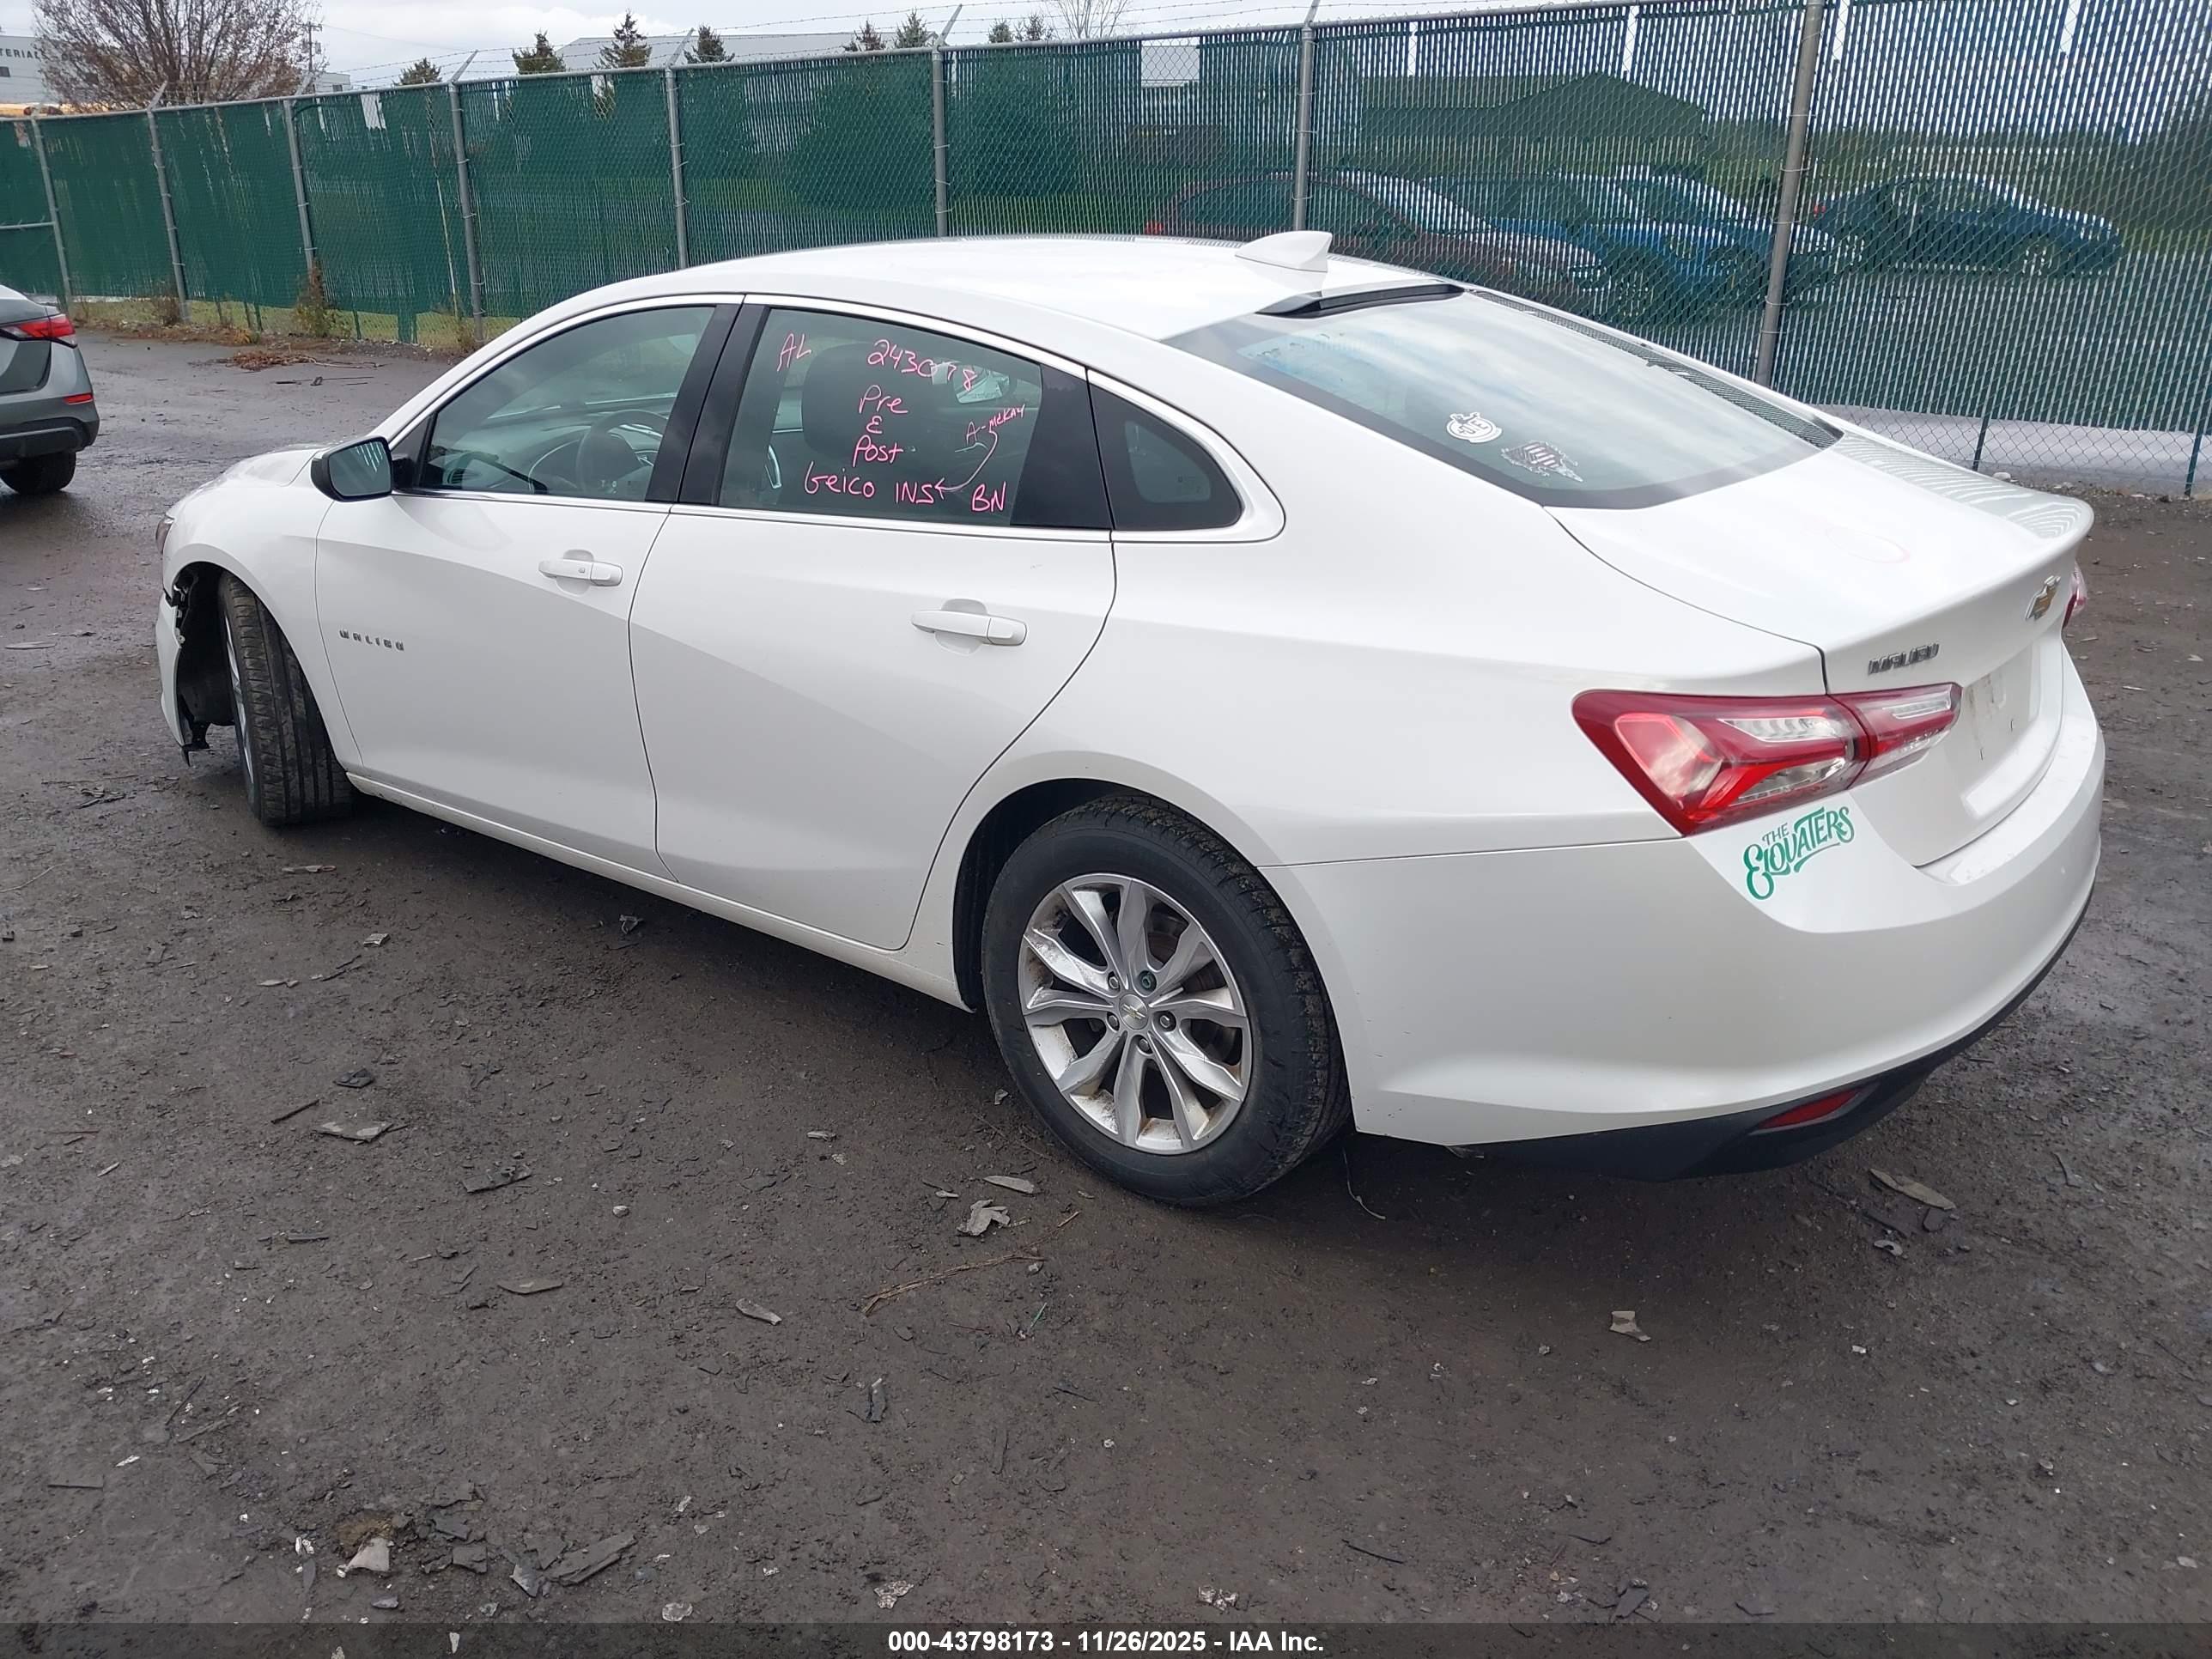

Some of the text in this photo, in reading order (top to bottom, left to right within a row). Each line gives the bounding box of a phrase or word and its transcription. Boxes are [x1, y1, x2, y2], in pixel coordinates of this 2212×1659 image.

[867, 339, 977, 392] 243078
[859, 385, 908, 415] Pre
[853, 434, 903, 467] Post
[896, 482, 934, 505] INS
[971, 482, 1007, 512] BN
[1868, 643, 1941, 675] MALIBU
[1762, 823, 1790, 846] THE
